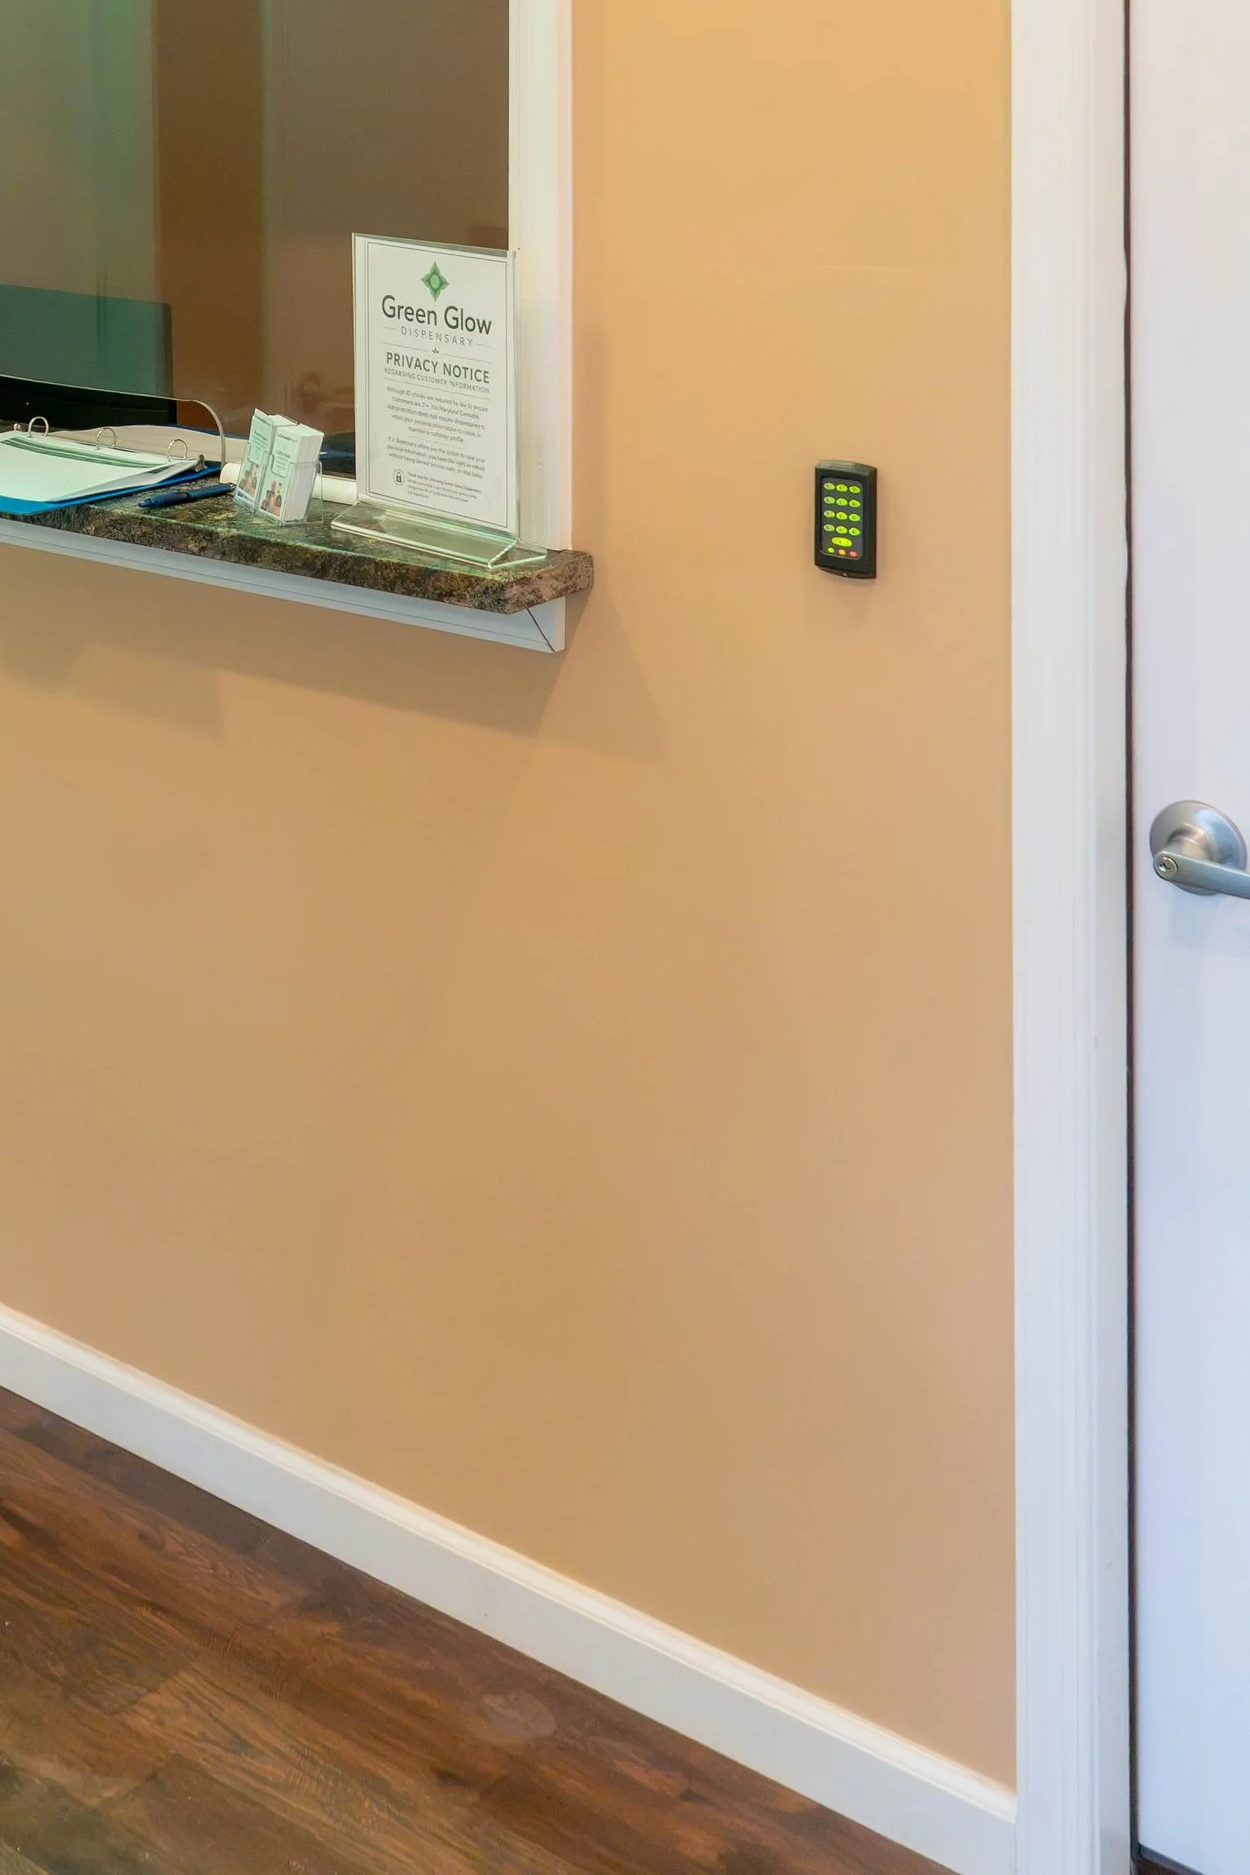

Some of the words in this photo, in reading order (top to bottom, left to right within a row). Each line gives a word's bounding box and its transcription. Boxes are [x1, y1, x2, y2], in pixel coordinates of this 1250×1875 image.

[381, 294, 437, 326] Green
[444, 305, 492, 335] Glow
[401, 326, 473, 347] DISPENSARY
[384, 367, 416, 380] REGARDING
[416, 374, 447, 385] CUSTOMER
[449, 381, 490, 394] INFORMATION
[386, 352, 438, 374] PRIVACY
[443, 363, 490, 384] NOTICE
